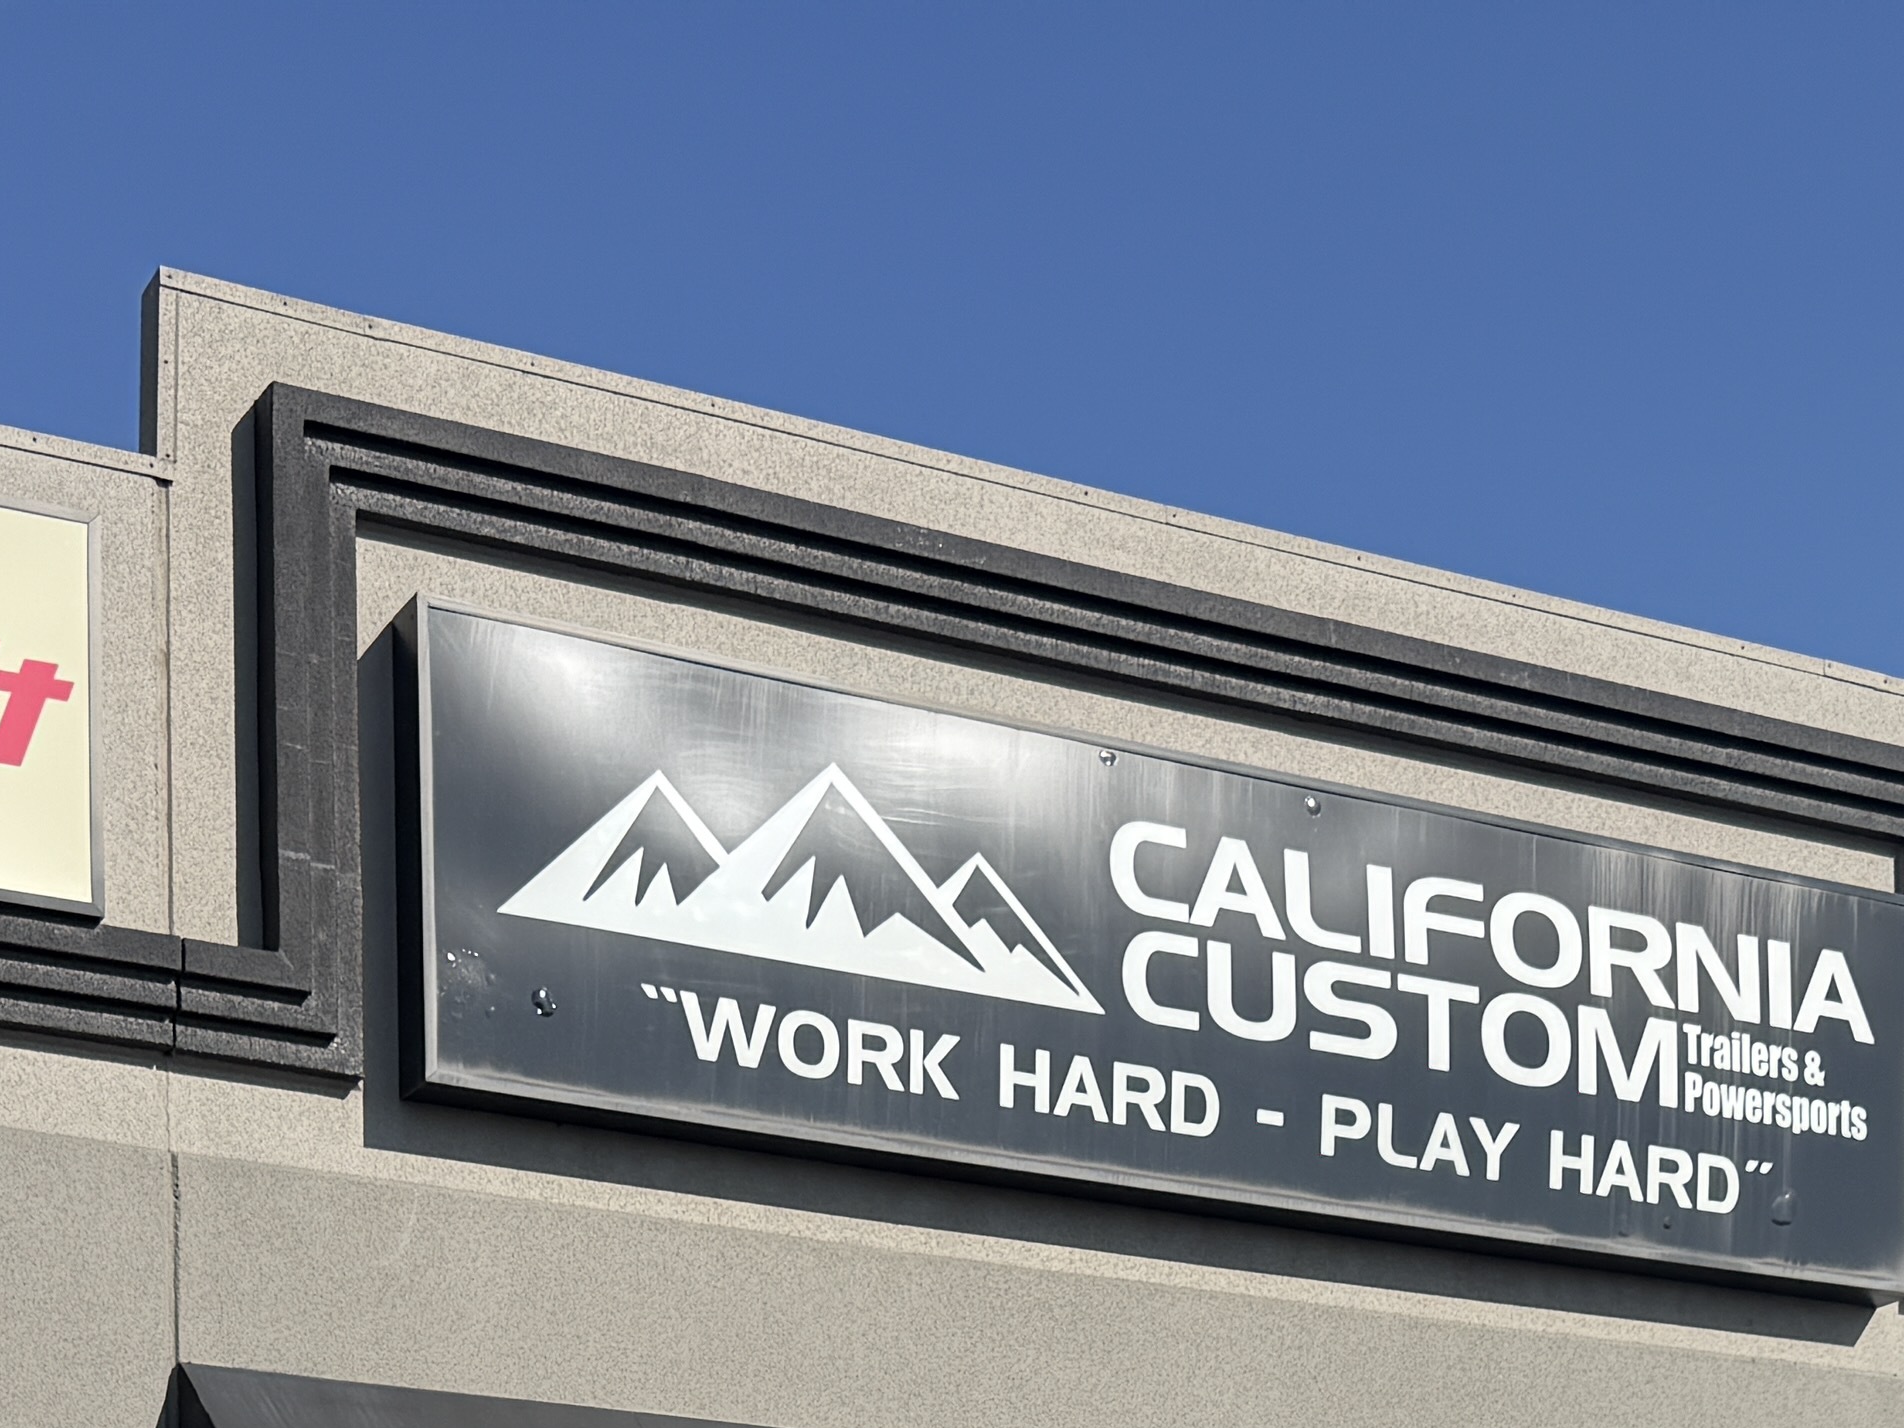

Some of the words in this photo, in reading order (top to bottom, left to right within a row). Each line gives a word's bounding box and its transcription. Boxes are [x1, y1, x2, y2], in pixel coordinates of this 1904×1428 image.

[1109, 820, 1876, 1045] CALIFORNIA
[1121, 932, 1679, 1108] CUSTOM
[1684, 1023, 1798, 1081] Trailers
[1803, 1050, 1826, 1087] &
[999, 1042, 1221, 1138] HARD
[1320, 1093, 1521, 1181] PLAY
[1684, 1071, 1869, 1142] Powersports
